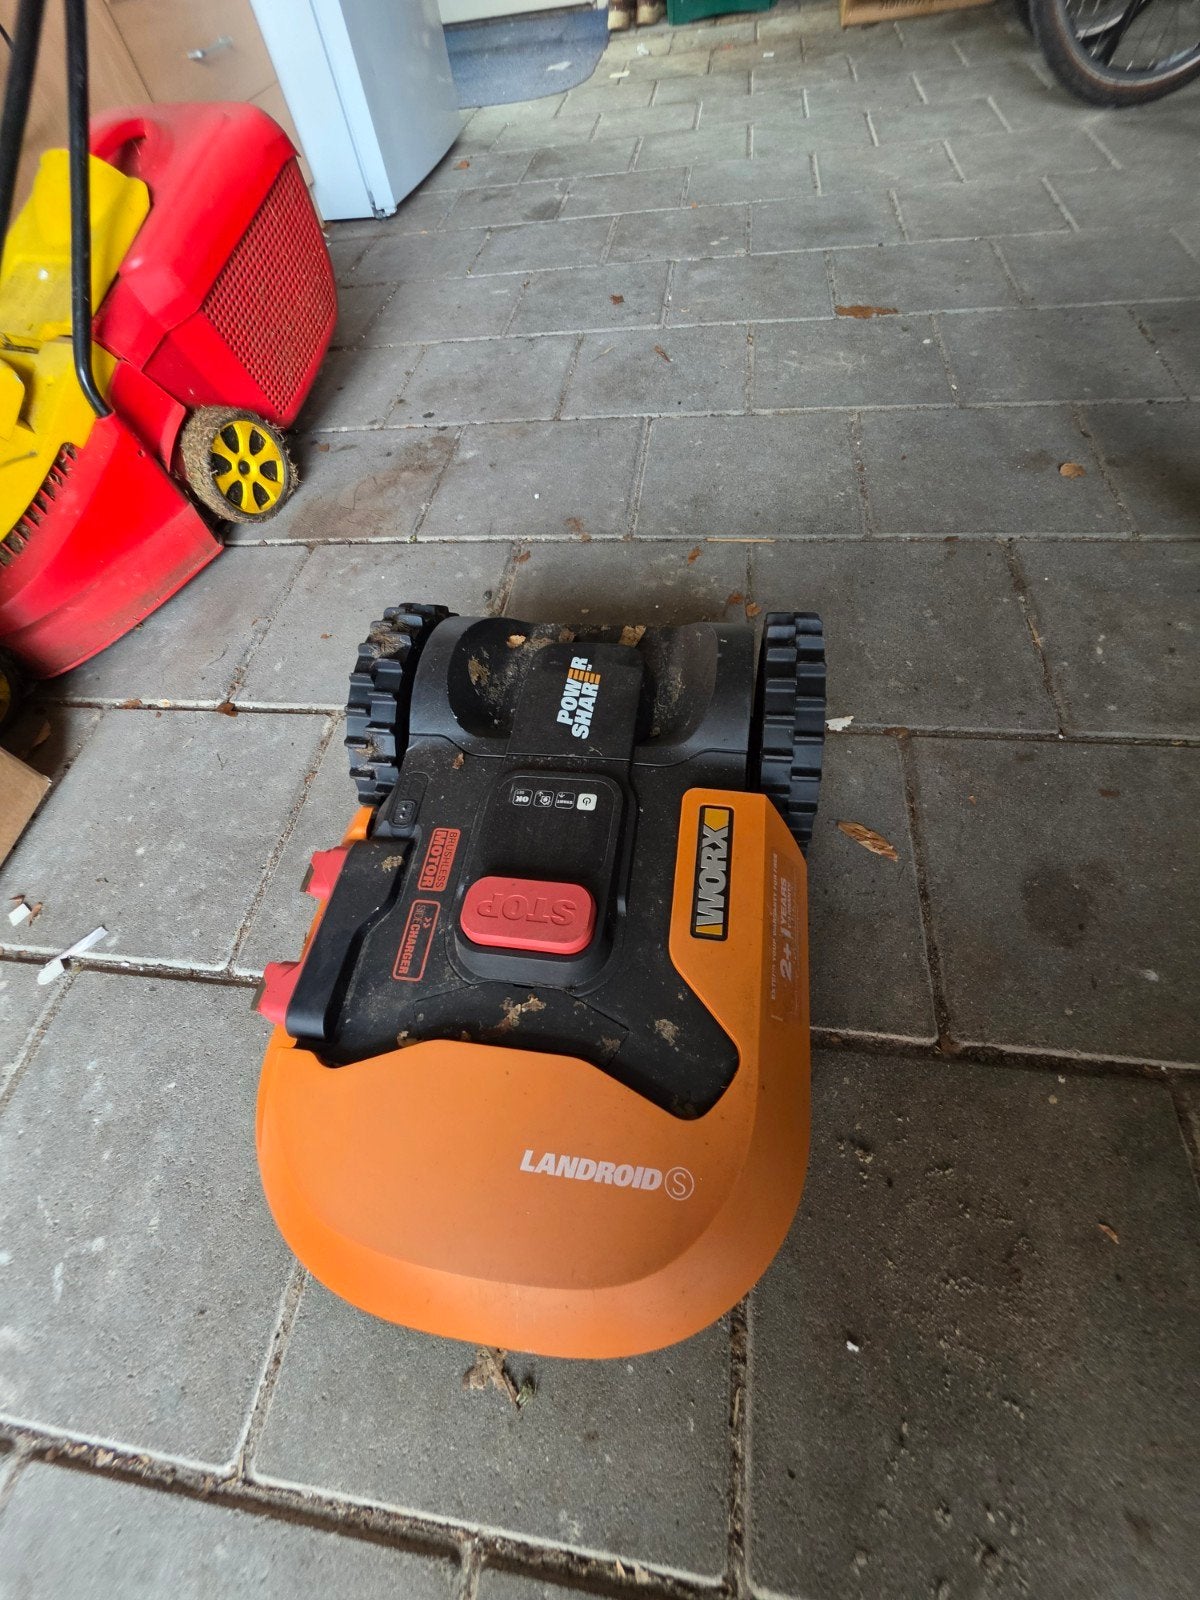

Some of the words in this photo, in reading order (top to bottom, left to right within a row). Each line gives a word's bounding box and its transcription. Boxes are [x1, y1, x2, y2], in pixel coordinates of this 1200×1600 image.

[556, 656, 589, 726] POWER
[571, 673, 602, 740] SHARE
[516, 795, 530, 803] OK
[421, 830, 447, 888] MOTOR
[435, 832, 458, 887] BRUSHLESS
[695, 824, 729, 926] WORX
[477, 893, 577, 928] STOP
[519, 1149, 662, 1192] LANDROID
